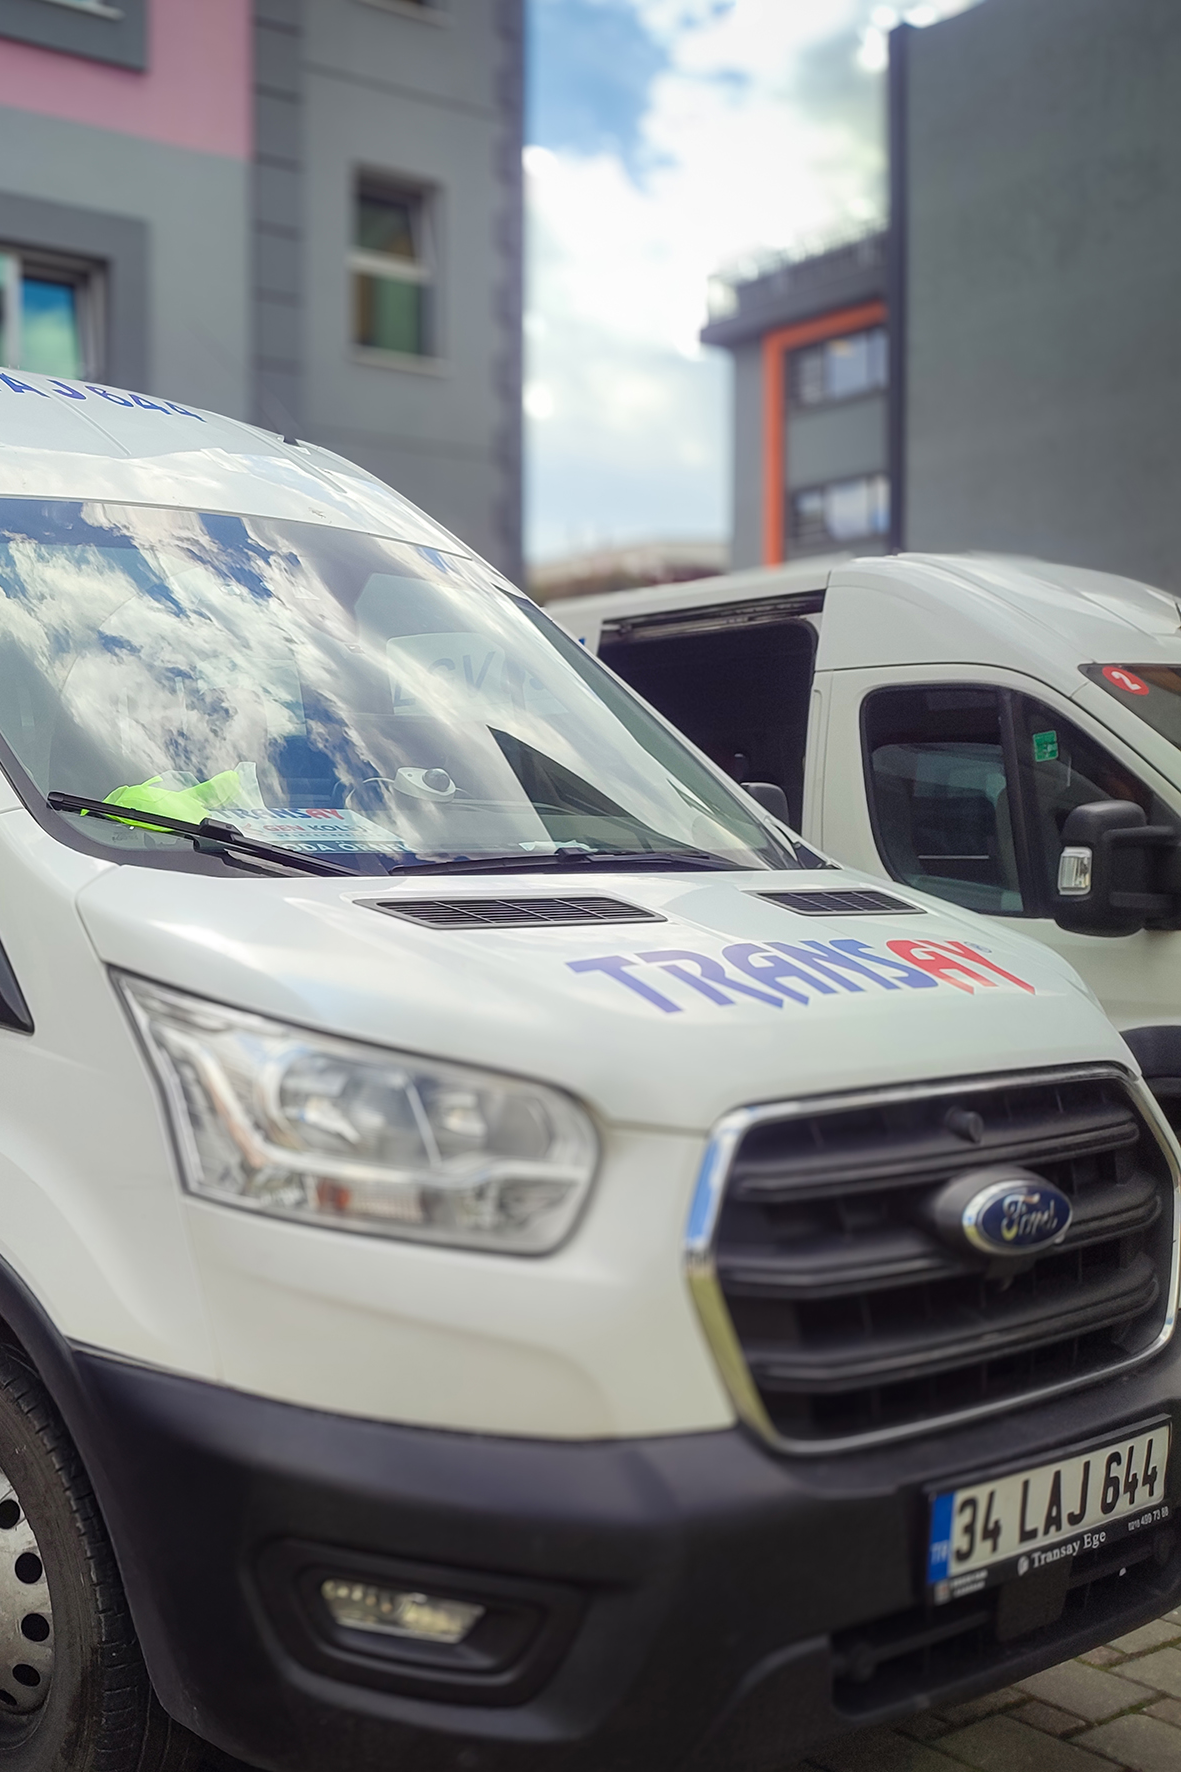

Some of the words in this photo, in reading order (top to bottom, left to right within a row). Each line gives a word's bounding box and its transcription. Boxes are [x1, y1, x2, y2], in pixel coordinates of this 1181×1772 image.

[1111, 671, 1142, 691] 2
[565, 938, 1037, 1014] TRANSAY
[1000, 1192, 1059, 1242] Ford
[954, 1490, 1003, 1565] 34
[1018, 1460, 1091, 1544] LAJ
[1100, 1438, 1158, 1516] 644
[1031, 1535, 1081, 1569] Transay
[1082, 1529, 1107, 1551] Ege
